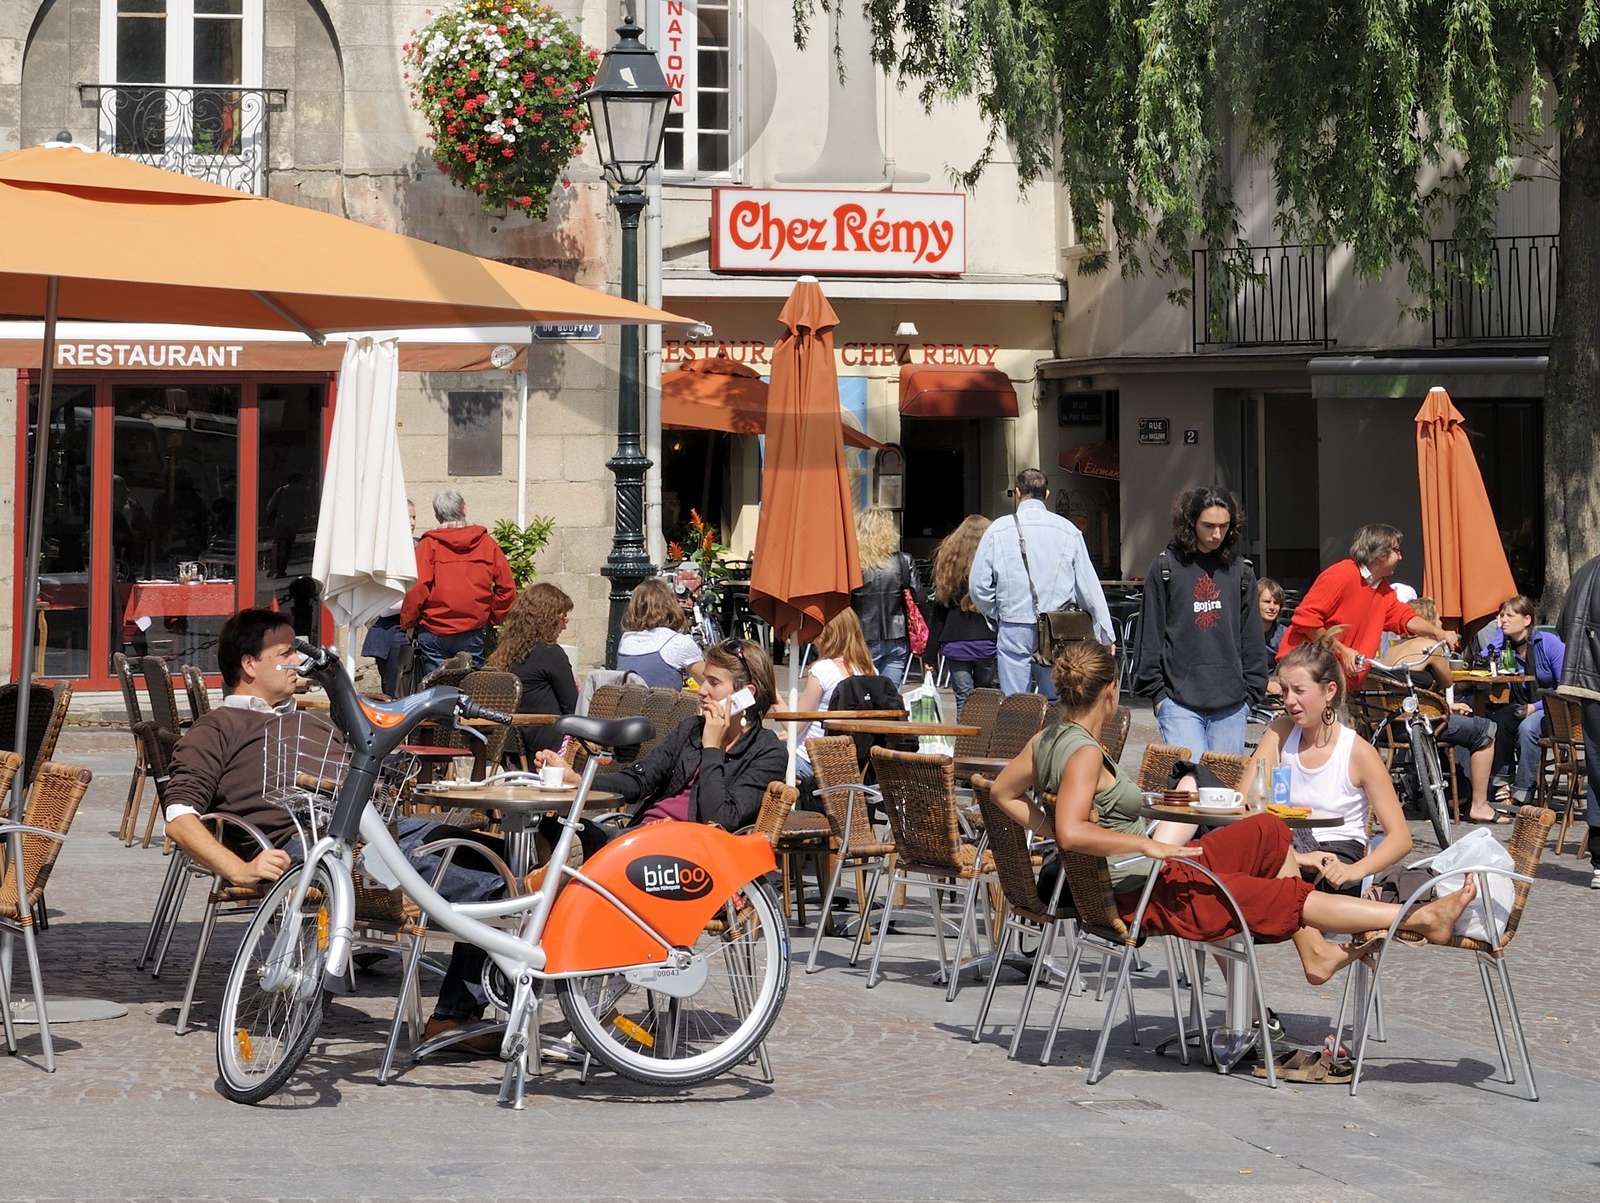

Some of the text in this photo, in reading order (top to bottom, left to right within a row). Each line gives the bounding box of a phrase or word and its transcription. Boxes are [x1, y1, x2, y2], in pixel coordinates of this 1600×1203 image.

[729, 200, 954, 263] Chez Rémy
[58, 344, 244, 367] RESTAURANT
[662, 340, 999, 366] ESTAUR CHEZ REMY
[1072, 401, 1089, 410] RUE
[1148, 422, 1163, 430] RUE
[1187, 431, 1195, 443] 2
[1193, 599, 1222, 613] gojira
[643, 863, 705, 887] bicloo
